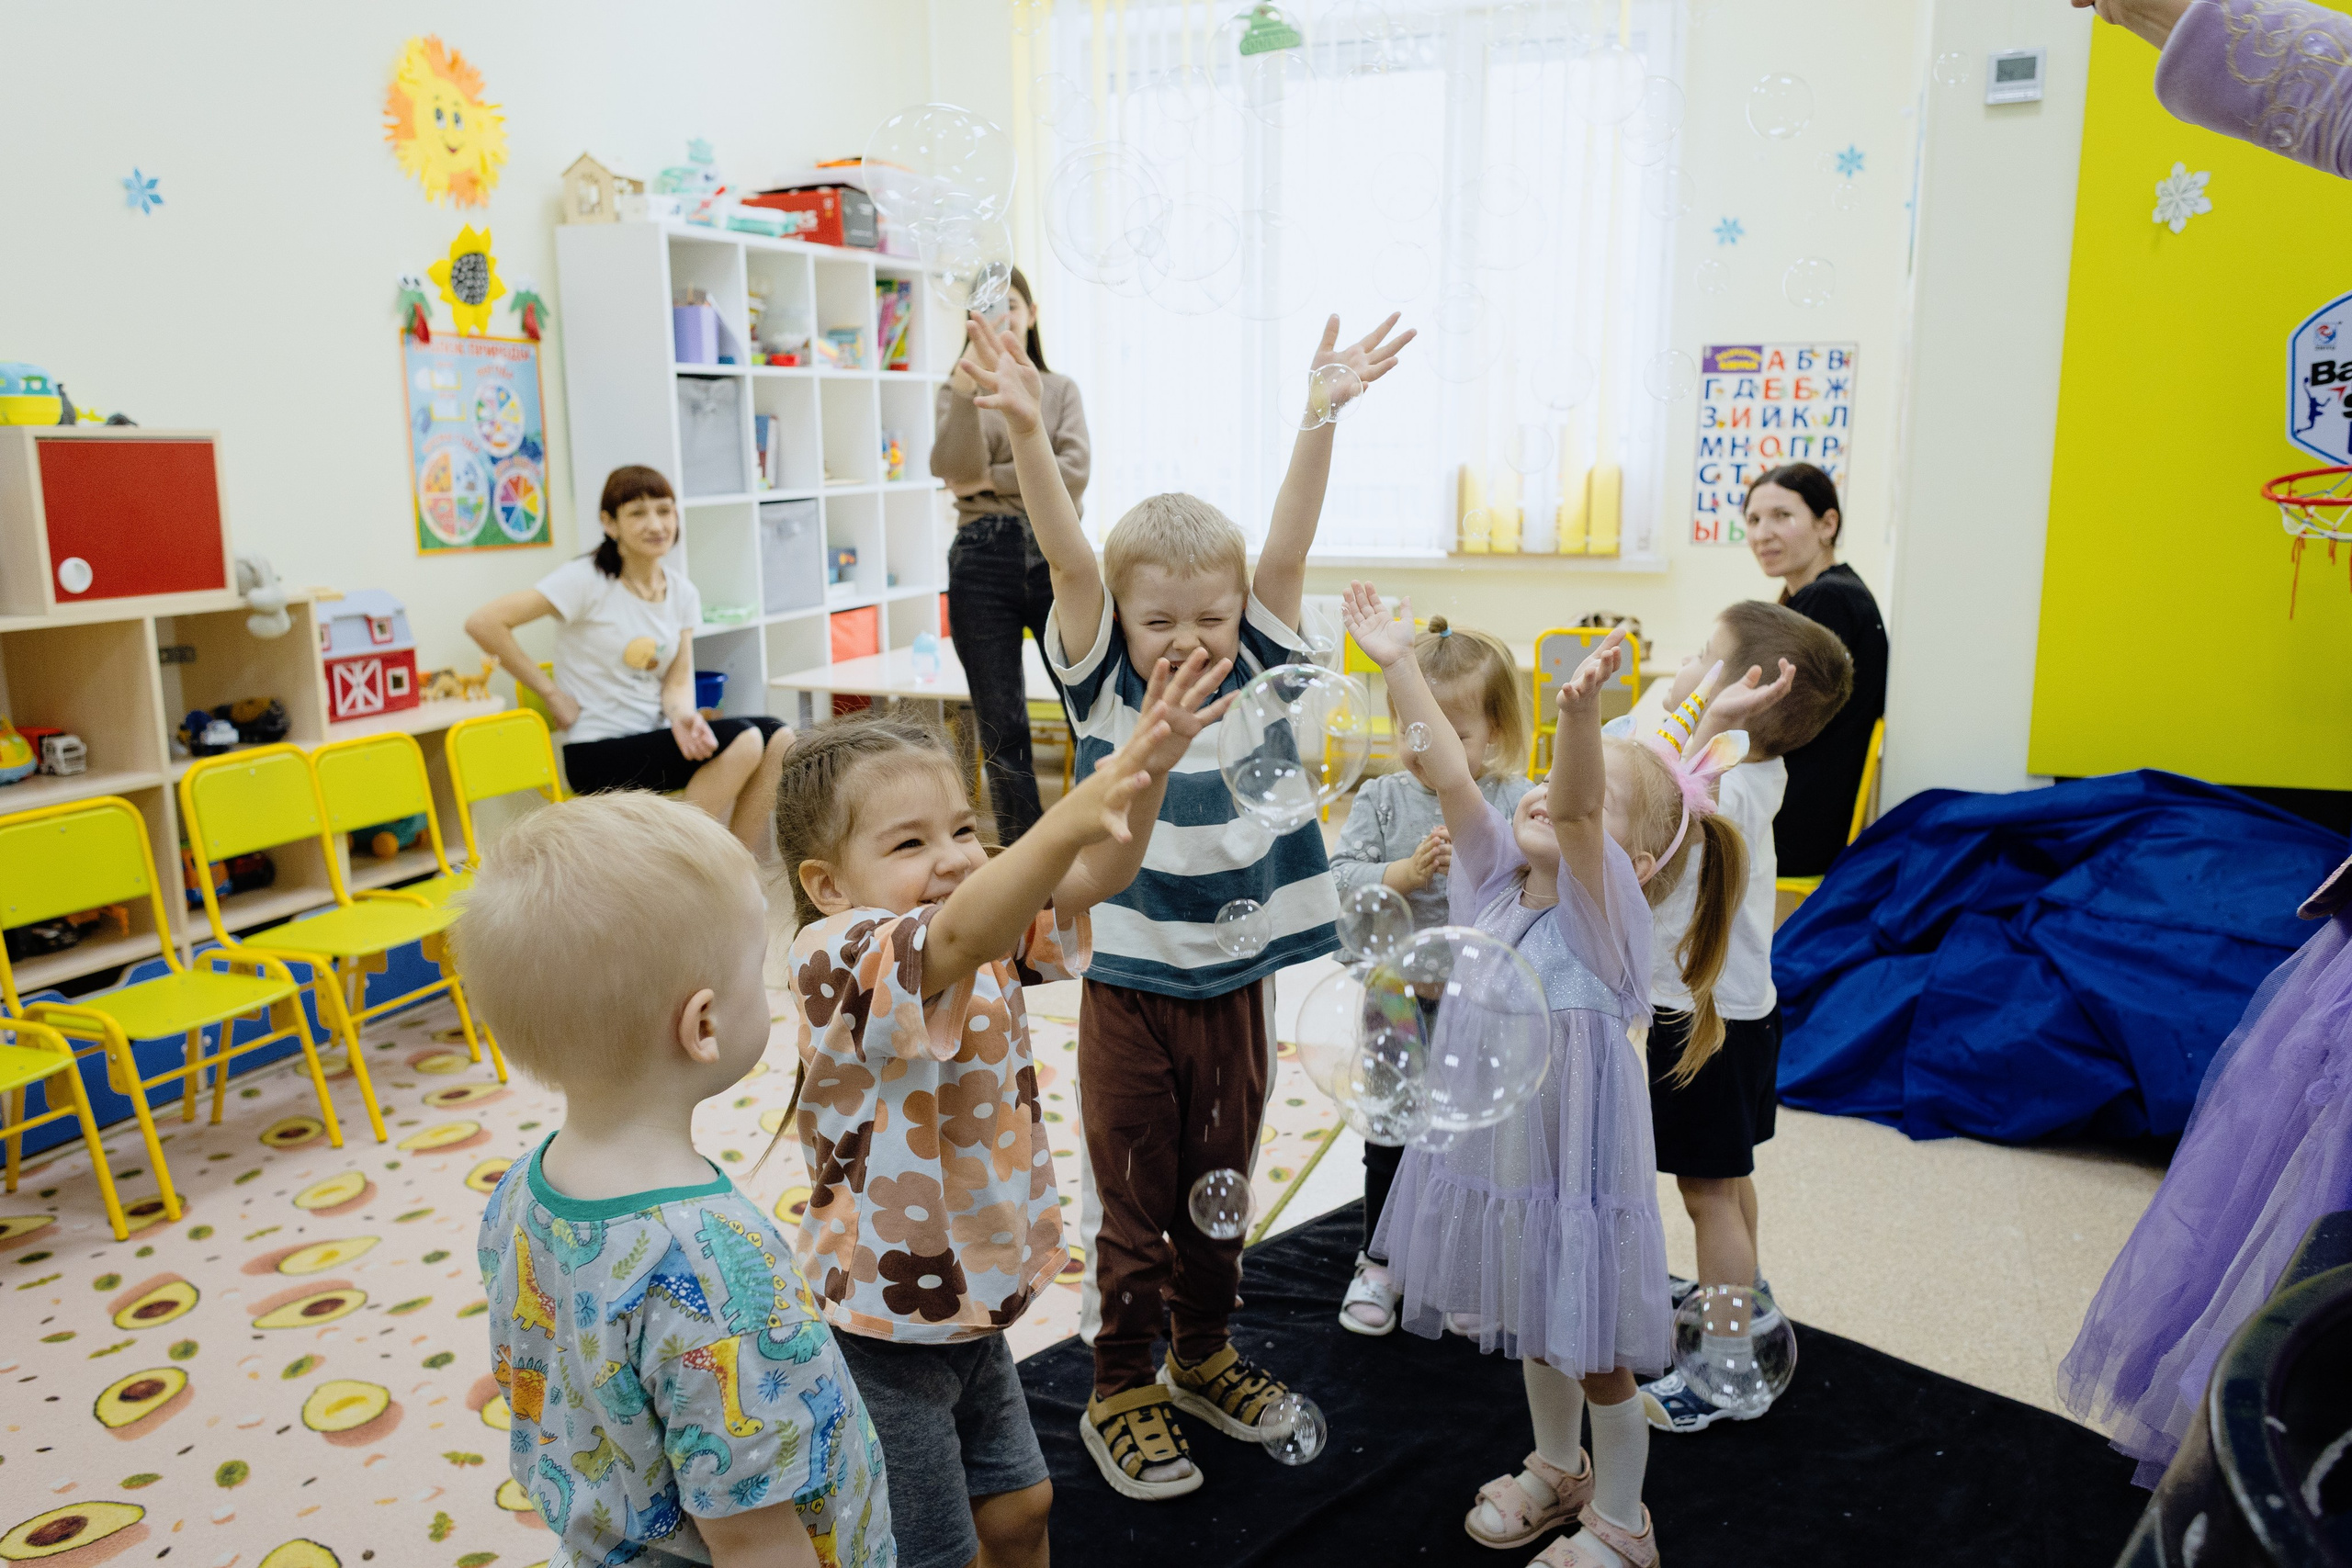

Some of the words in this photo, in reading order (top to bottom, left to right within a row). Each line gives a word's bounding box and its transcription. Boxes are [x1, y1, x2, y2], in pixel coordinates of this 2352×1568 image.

[1768, 349, 1785, 371] А
[1799, 349, 1813, 370] Б
[1829, 349, 1843, 370] В
[1705, 378, 1721, 400] Г
[1735, 378, 1755, 400] Д
[1764, 378, 1781, 400] Е
[1826, 377, 1849, 399] Ж
[1702, 406, 1717, 428] З
[1732, 407, 1750, 429] И
[1792, 406, 1808, 428] К
[1828, 406, 1848, 427] Л
[1700, 436, 1723, 457] М
[1731, 436, 1749, 457] Н
[1760, 435, 1781, 458] О
[1791, 436, 1809, 457] П
[1823, 436, 1838, 457] Р
[1700, 463, 1718, 485] С
[1730, 463, 1748, 484] Т
[1698, 492, 1717, 514] Ц
